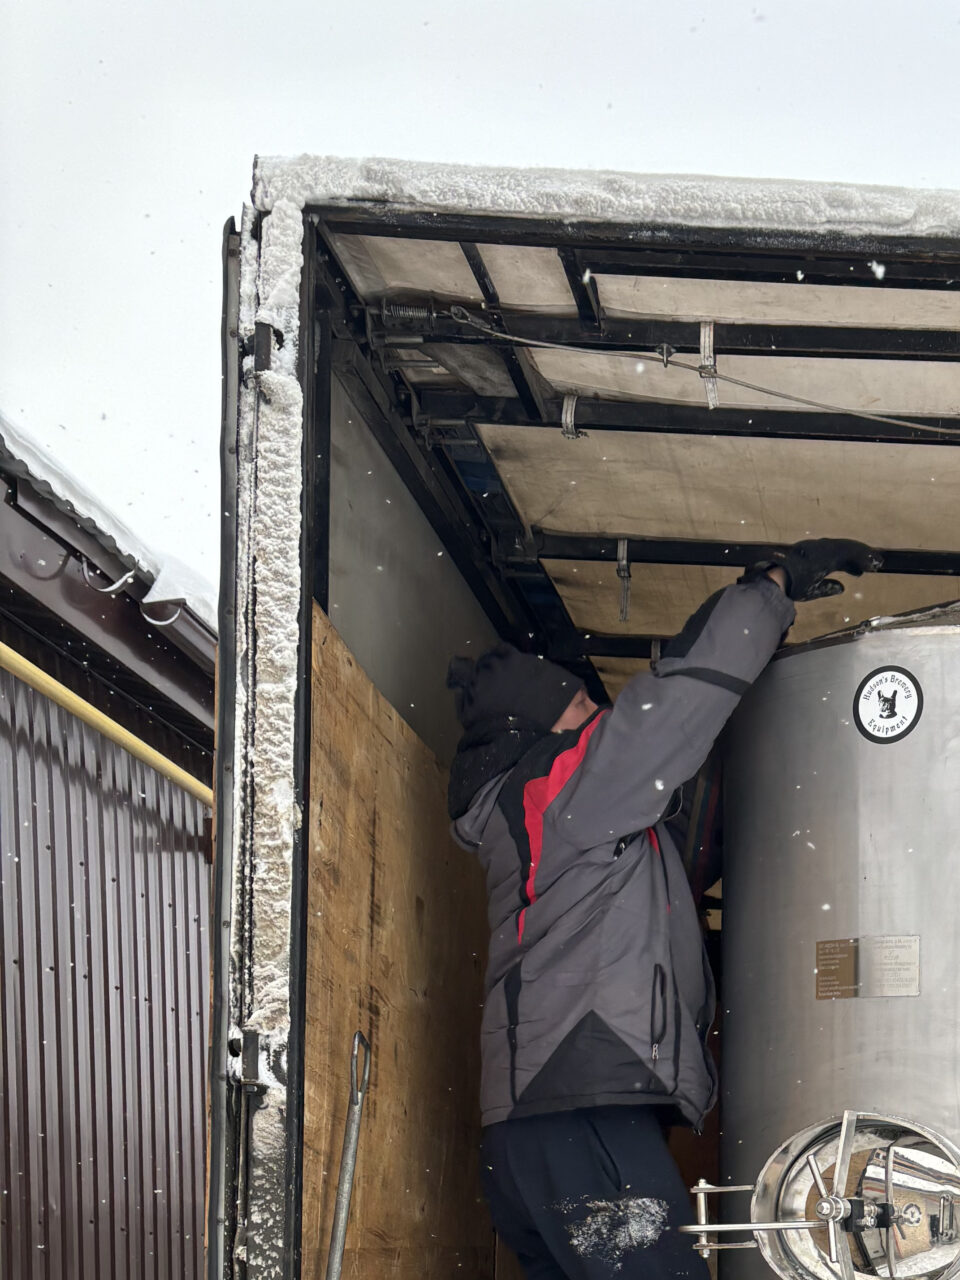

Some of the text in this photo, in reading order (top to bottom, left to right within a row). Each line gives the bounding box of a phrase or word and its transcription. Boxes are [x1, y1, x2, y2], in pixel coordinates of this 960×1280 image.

[863, 674, 912, 700] Hudson's Brewery
[868, 715, 907, 736] Equipment
